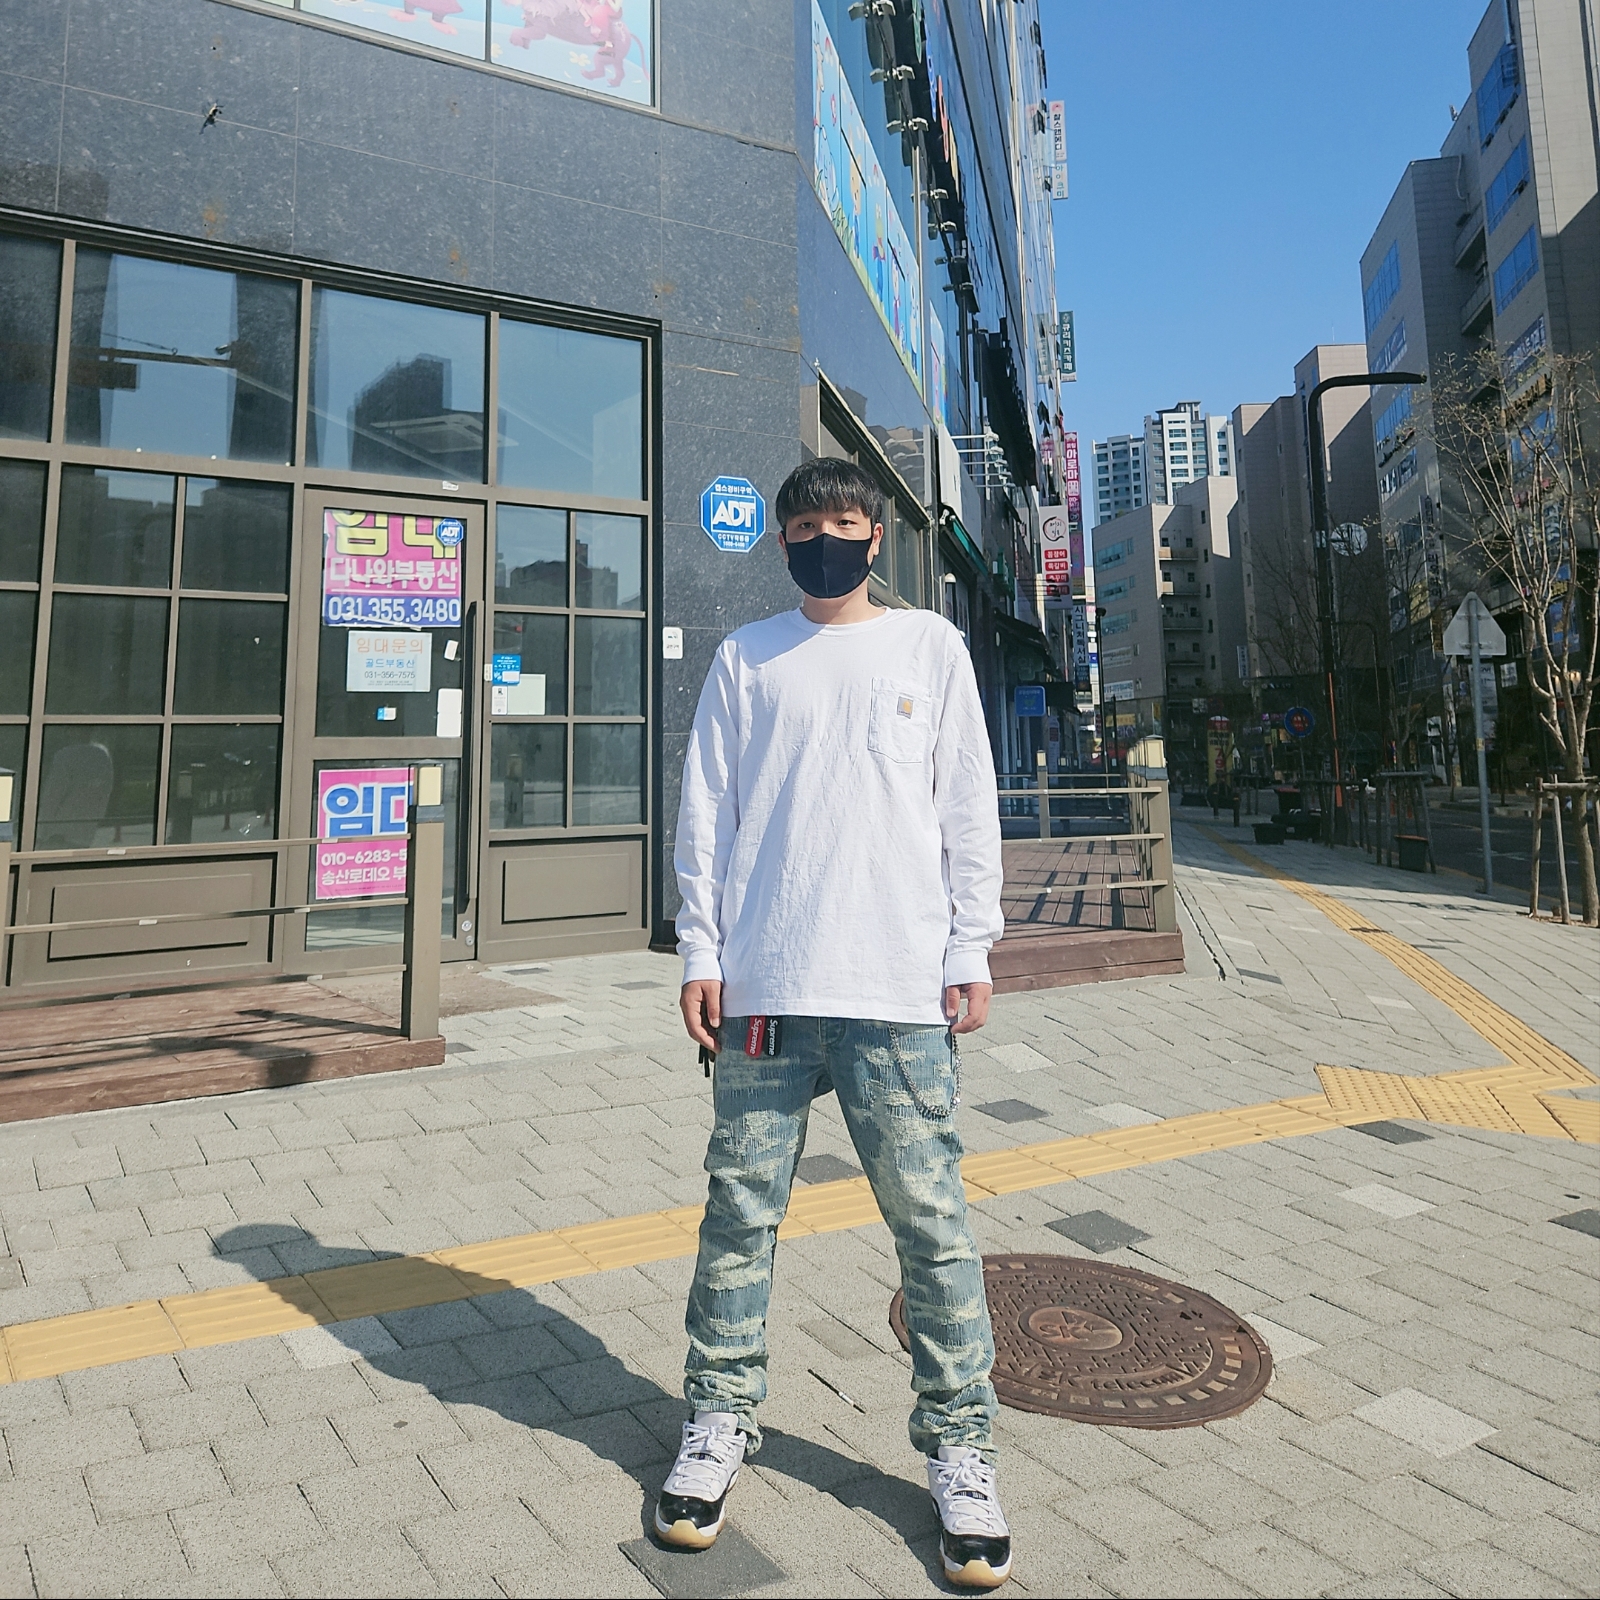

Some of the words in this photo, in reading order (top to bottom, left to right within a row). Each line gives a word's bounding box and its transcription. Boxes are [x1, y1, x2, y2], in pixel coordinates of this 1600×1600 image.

[713, 500, 755, 528] ADT
[442, 527, 460, 537] ADT
[331, 558, 458, 590] 다나와부동산
[330, 598, 460, 622] 031.355.3480
[357, 638, 423, 654] 임대문의
[366, 658, 414, 668] 골드부동산
[322, 867, 390, 886] 송산로데오
[750, 1018, 762, 1054] Supreme
[767, 1019, 778, 1056] Supreme
[1092, 1370, 1184, 1392] telecom
